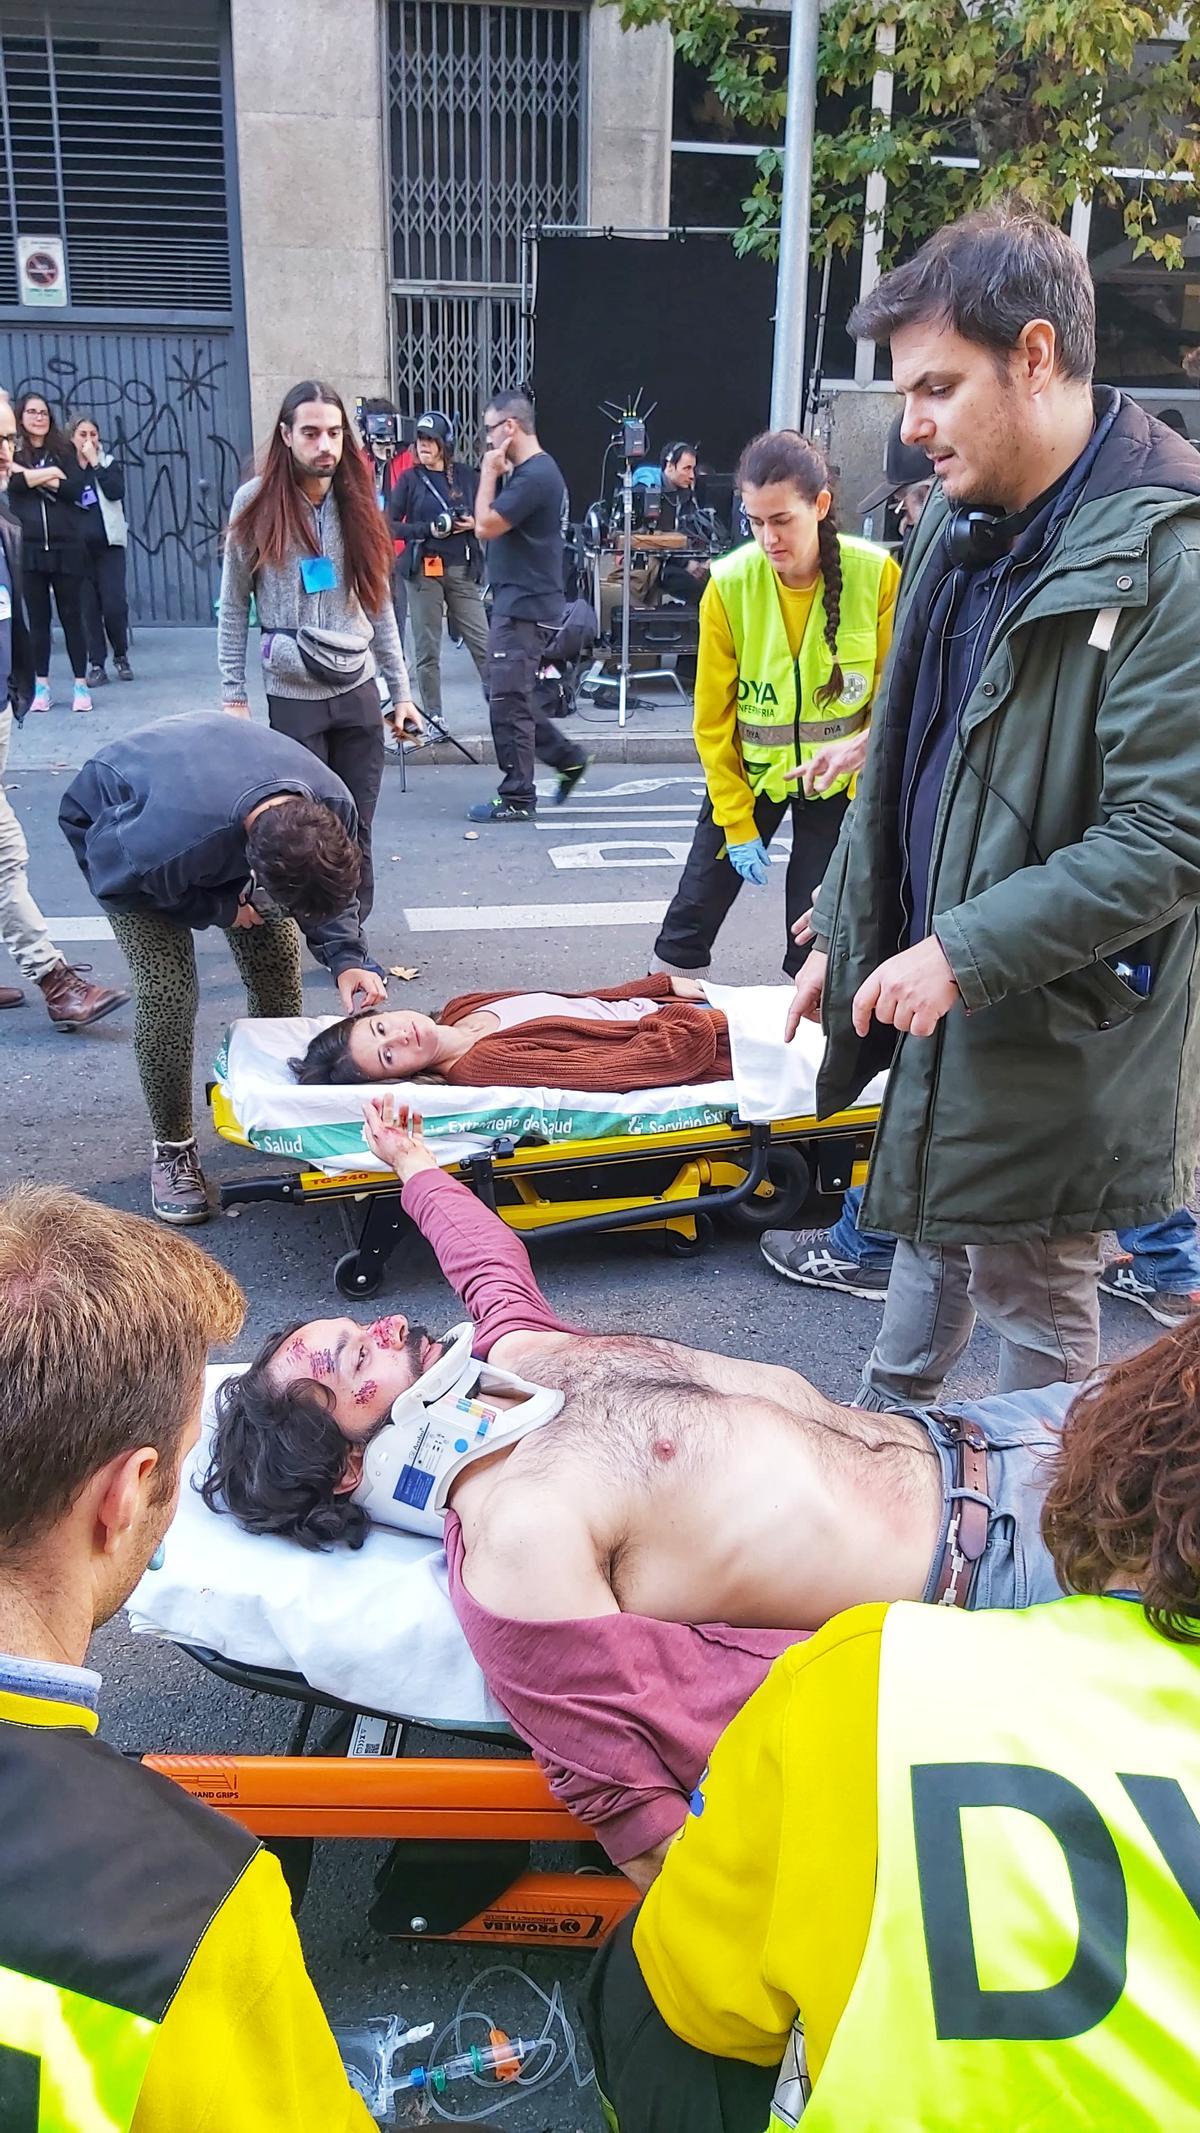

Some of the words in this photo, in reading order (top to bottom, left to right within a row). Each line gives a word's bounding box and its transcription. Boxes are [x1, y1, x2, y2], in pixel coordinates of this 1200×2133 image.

[736, 680, 779, 705] DYA
[823, 724, 842, 736] DYA
[522, 1112, 541, 1132] de
[263, 1134, 304, 1154] Salud
[215, 1791, 239, 1799] GRIPS
[484, 1921, 557, 1934] PROMEBA
